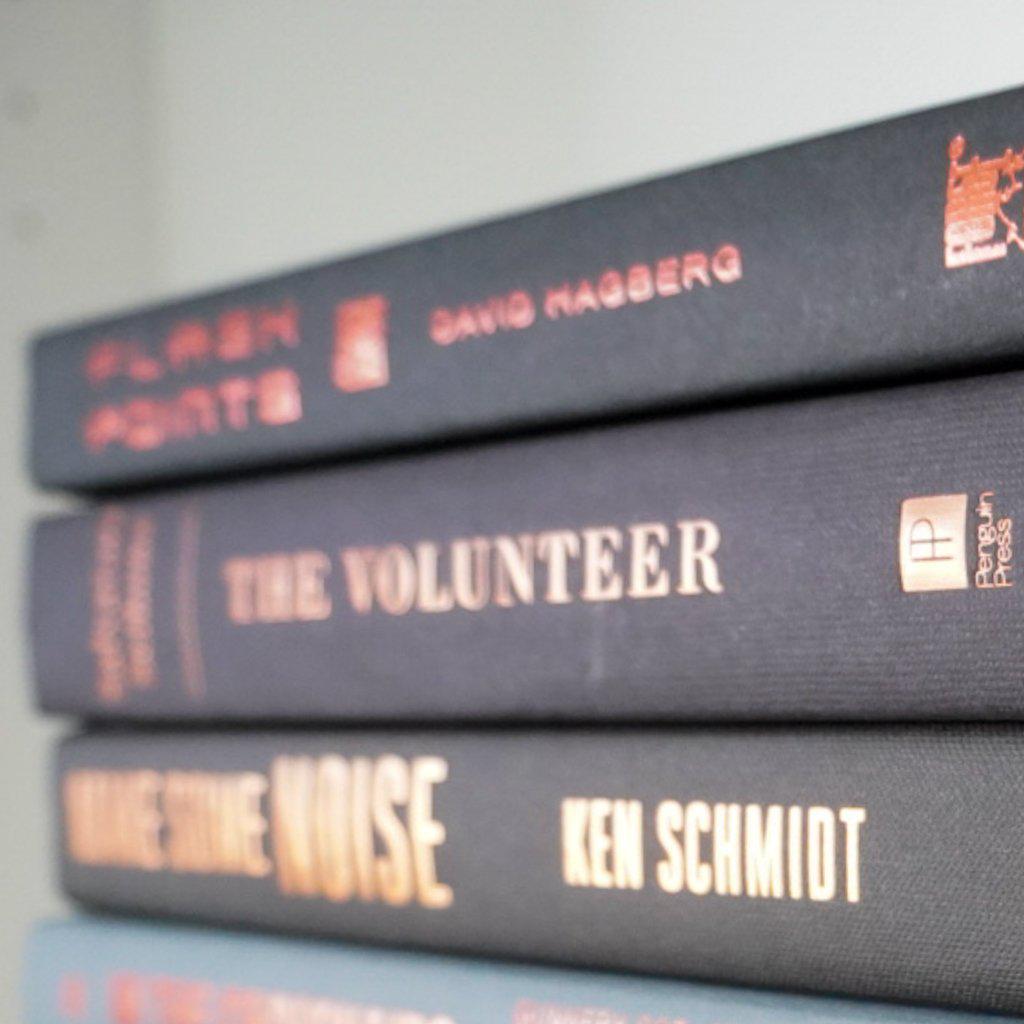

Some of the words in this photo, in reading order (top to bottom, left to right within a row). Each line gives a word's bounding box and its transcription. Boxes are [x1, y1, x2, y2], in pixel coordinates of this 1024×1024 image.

[429, 290, 536, 346] DAVID
[222, 549, 332, 625] THE
[341, 518, 724, 616] VOLUNTEER
[976, 492, 997, 588] Penguin
[993, 517, 1014, 588] Press
[271, 754, 453, 909] NOISE
[561, 797, 643, 890] KEN
[656, 799, 866, 902] SCHMIDT
